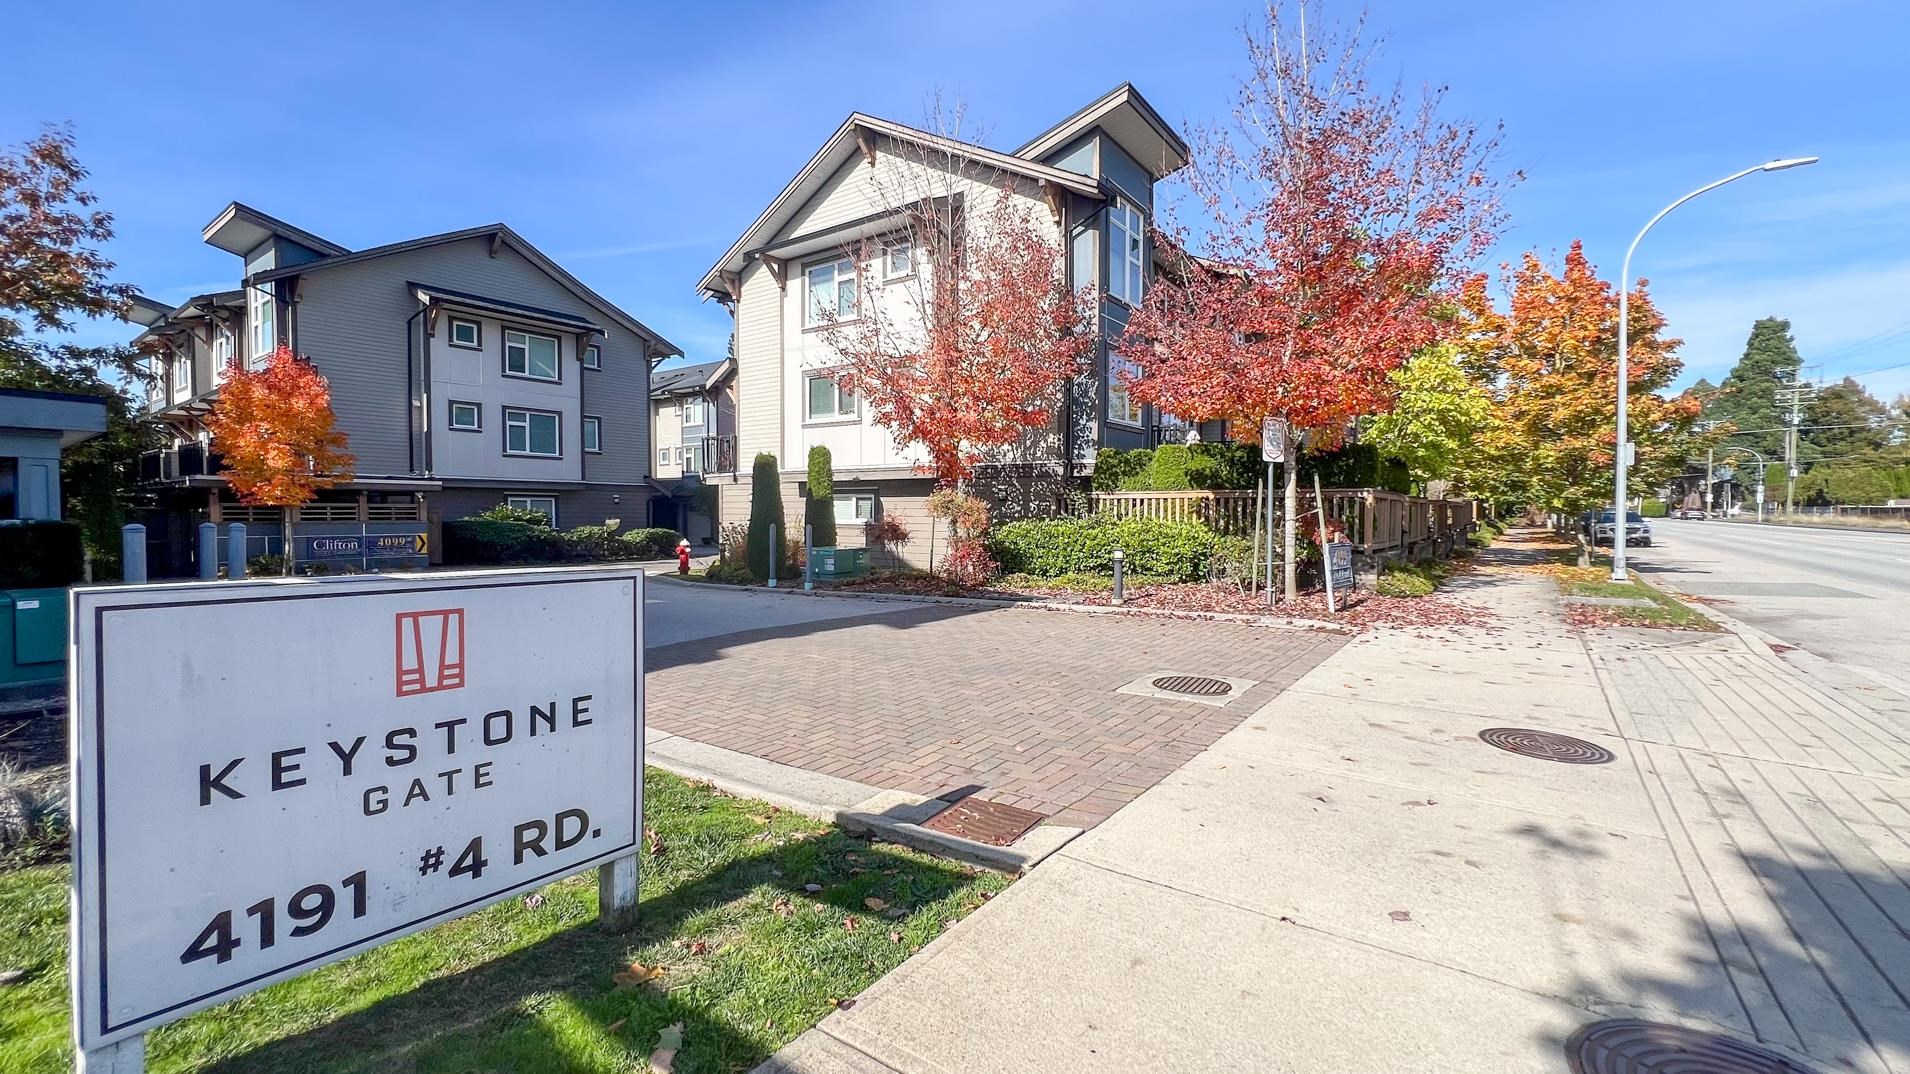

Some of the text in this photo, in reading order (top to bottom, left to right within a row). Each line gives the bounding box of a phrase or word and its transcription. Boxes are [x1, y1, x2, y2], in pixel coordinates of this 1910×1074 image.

[313, 539, 359, 550] Clifton
[377, 537, 406, 546] 4099
[199, 694, 594, 807] KEYSTONE
[362, 761, 494, 817] GATE
[179, 808, 602, 965] 4191 #4 RD.
